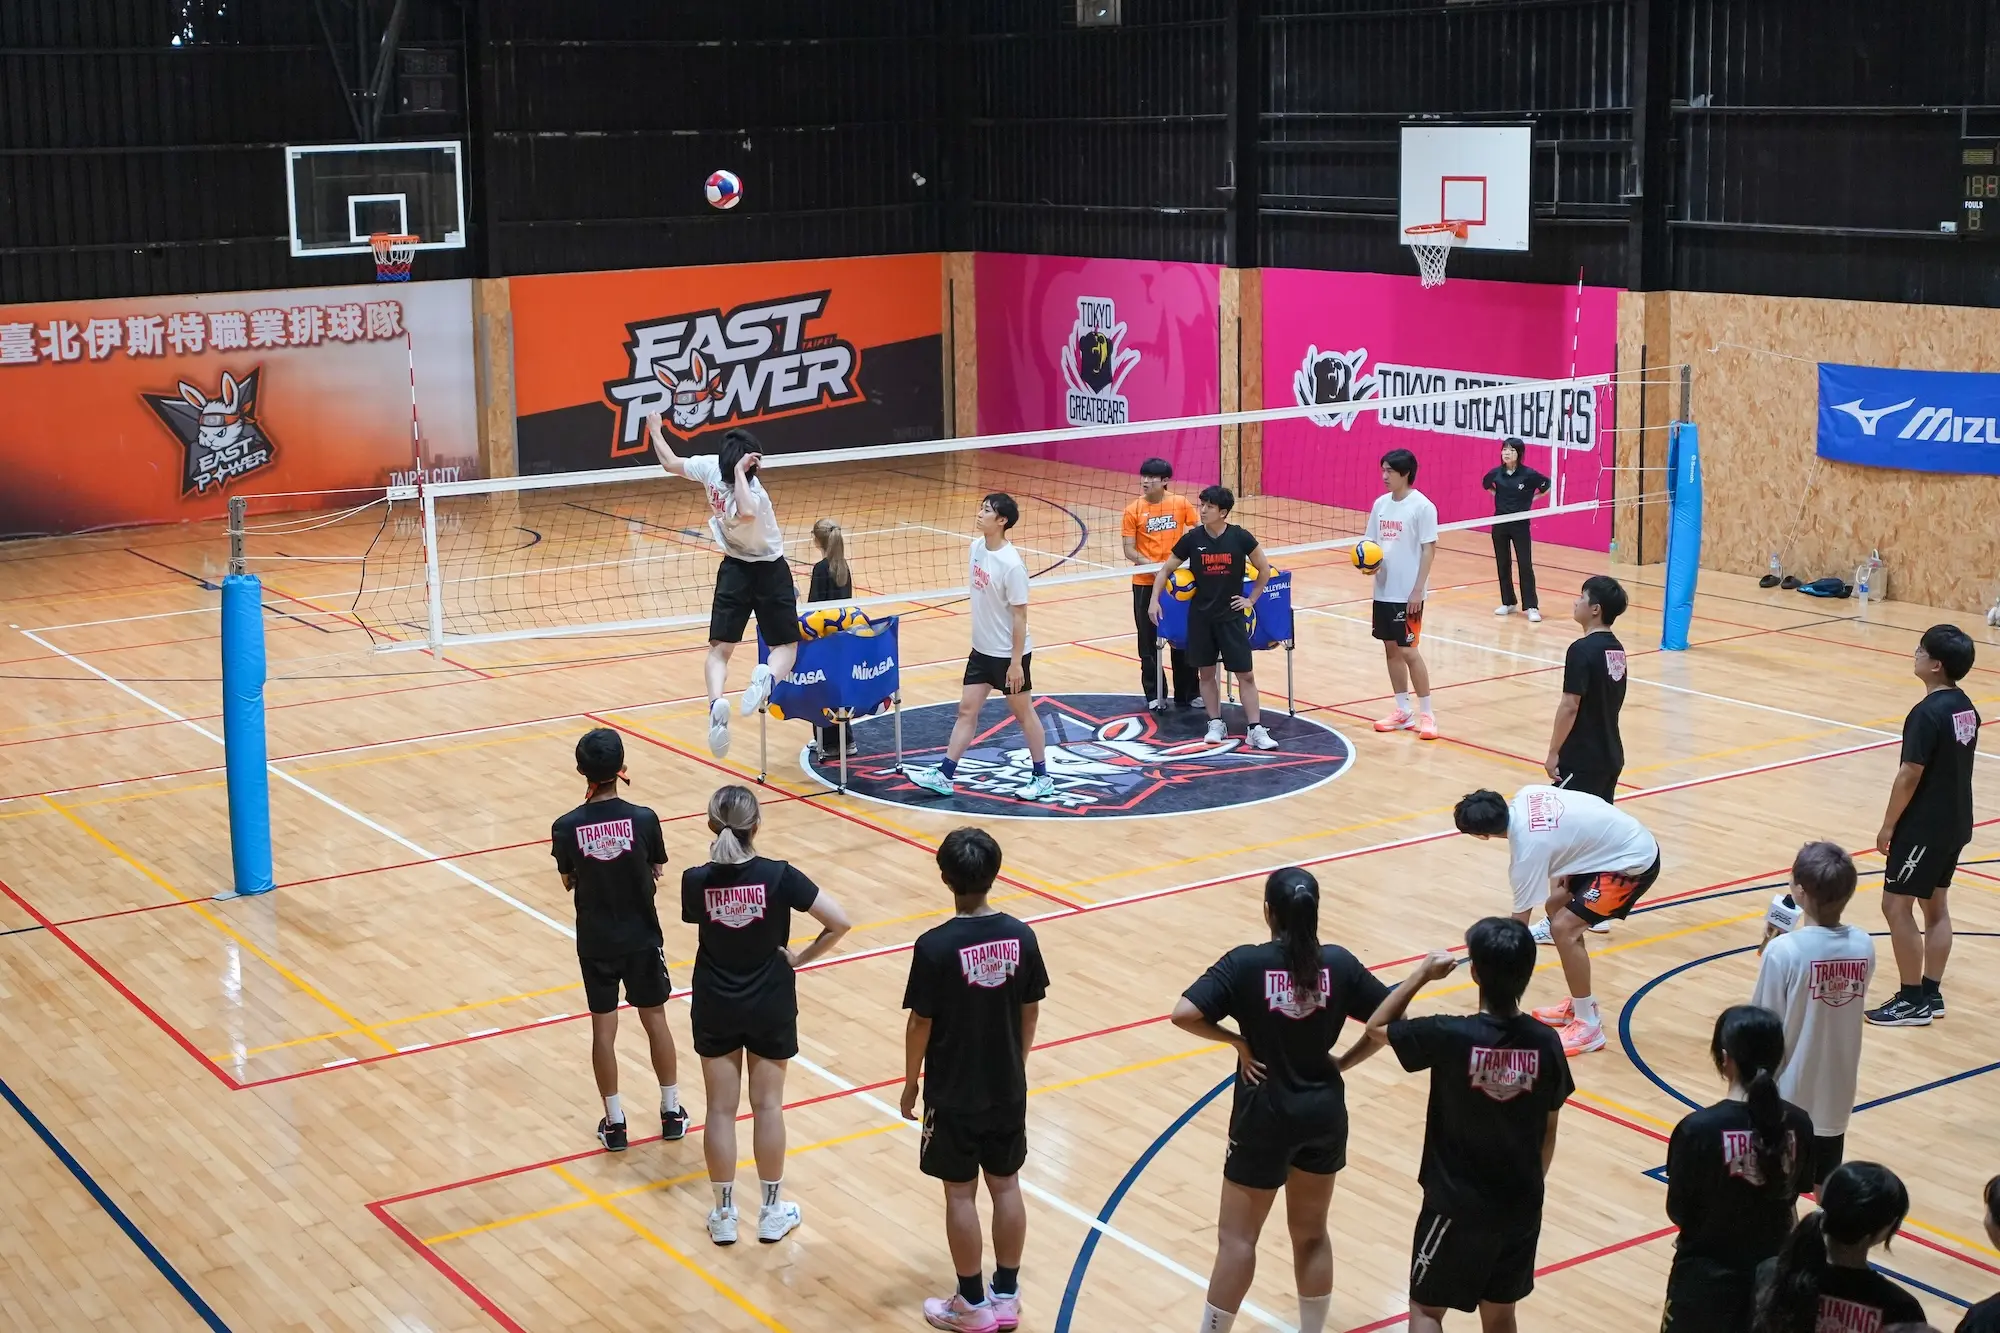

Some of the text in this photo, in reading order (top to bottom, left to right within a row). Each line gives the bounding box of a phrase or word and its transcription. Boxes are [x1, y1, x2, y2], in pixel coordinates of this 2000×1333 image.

[1964, 201, 1984, 209] FOULS
[1080, 302, 1113, 330] TOKYO
[0, 301, 403, 364] 臺北伊斯特職業排球隊
[632, 298, 822, 379] EAST
[1378, 369, 1447, 426] TOKYO
[1069, 394, 1126, 425] GREATBEARS
[198, 436, 254, 473] EAST
[432, 466, 460, 484] CITY
[1262, 582, 1291, 594] OLLEYBALL
[783, 669, 827, 686] IKASA
[579, 821, 631, 845] TRAINING
[596, 837, 616, 849] CAMP
[708, 887, 763, 909] TRAINING
[725, 904, 747, 915] CAMP
[963, 942, 1018, 970] TRAINING
[980, 960, 1003, 974] CAMP
[1814, 961, 1866, 984] TRAINING
[1476, 1050, 1536, 1075] TRAINING
